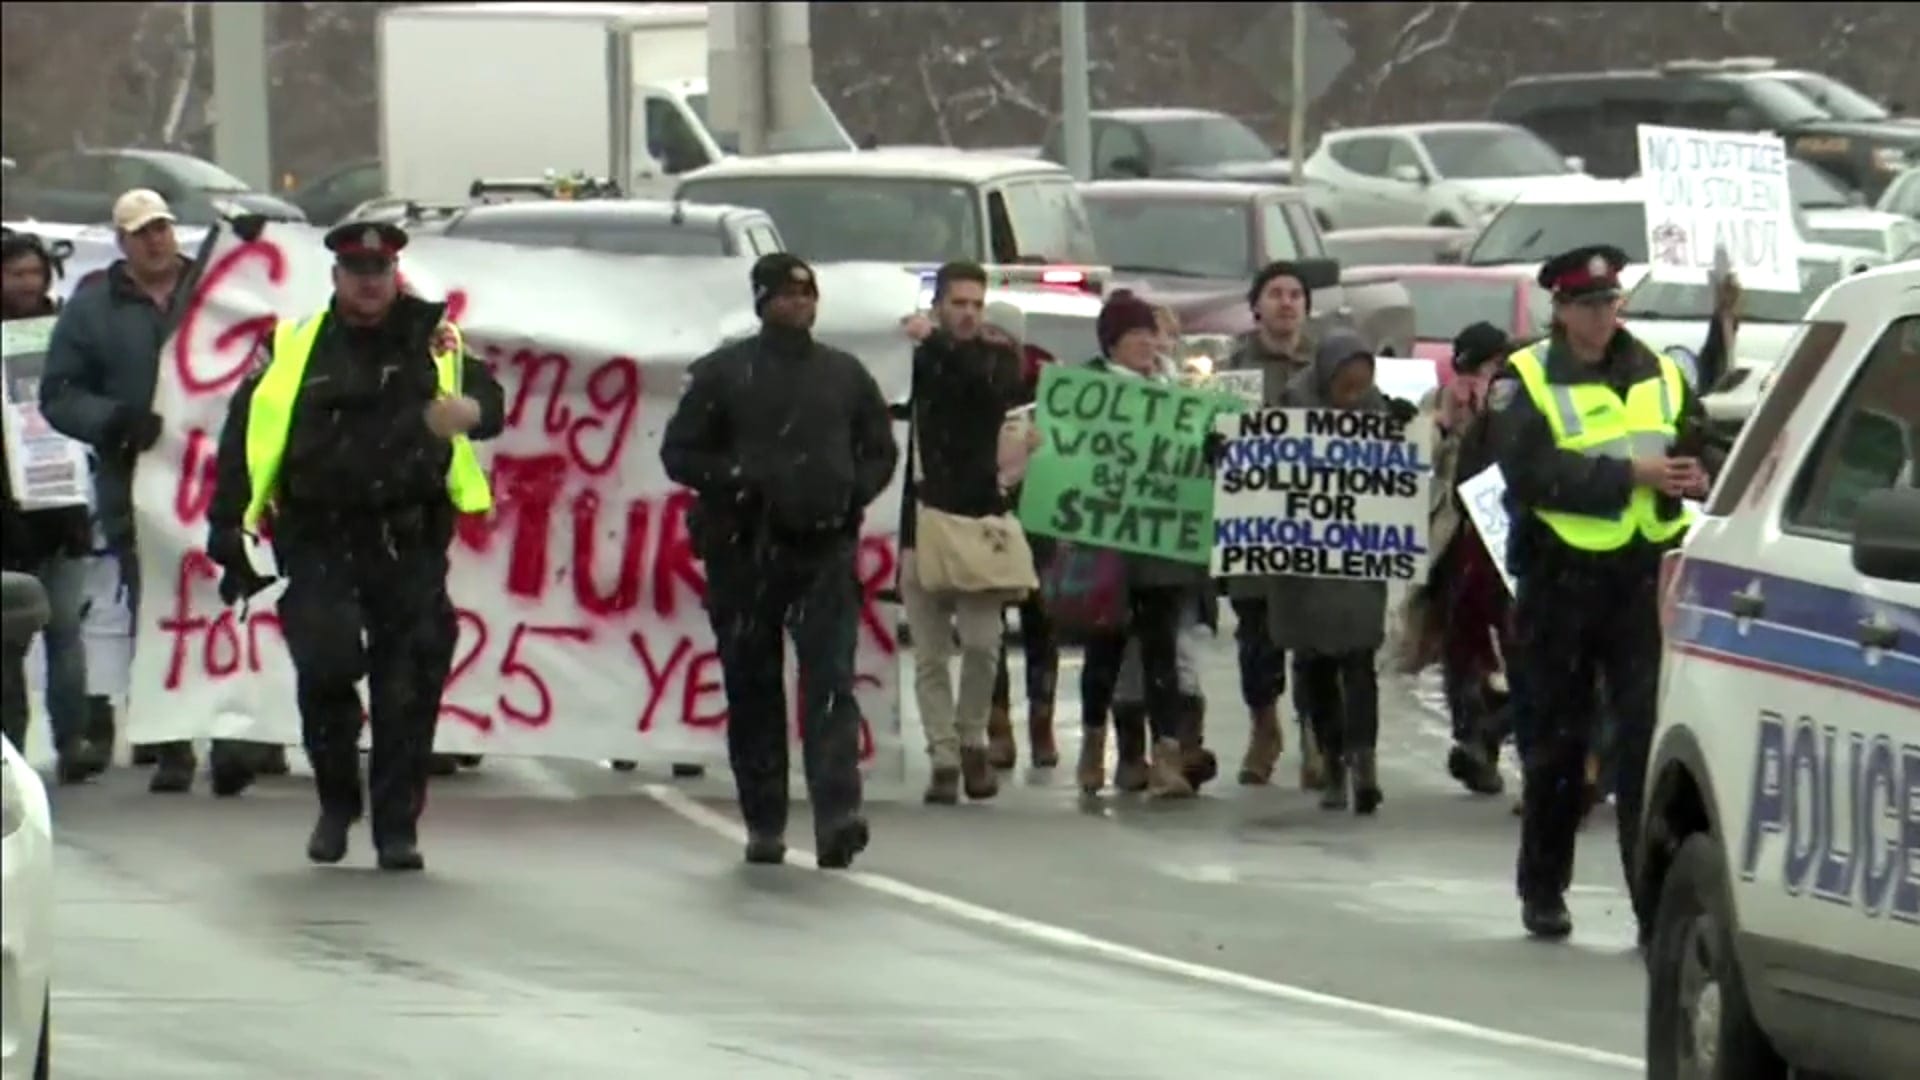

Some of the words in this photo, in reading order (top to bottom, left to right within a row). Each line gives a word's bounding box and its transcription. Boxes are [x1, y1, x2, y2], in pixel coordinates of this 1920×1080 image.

[1648, 136, 1680, 172] NO
[1687, 137, 1782, 175] JUSTICE
[1659, 175, 1693, 206] ON
[1702, 176, 1781, 211] STOLEN
[1240, 411, 1288, 437] NO
[1306, 411, 1405, 442] MORE
[1222, 464, 1418, 497] SOLUTIONS
[1052, 488, 1204, 550] STATE
[1286, 492, 1356, 521] FOR
[1214, 516, 1428, 554] KKKOLONIAL
[1221, 546, 1416, 579] PROBLEMS
[159, 548, 286, 691] for
[440, 609, 594, 736] 25
[1738, 708, 1920, 926] POLICE
